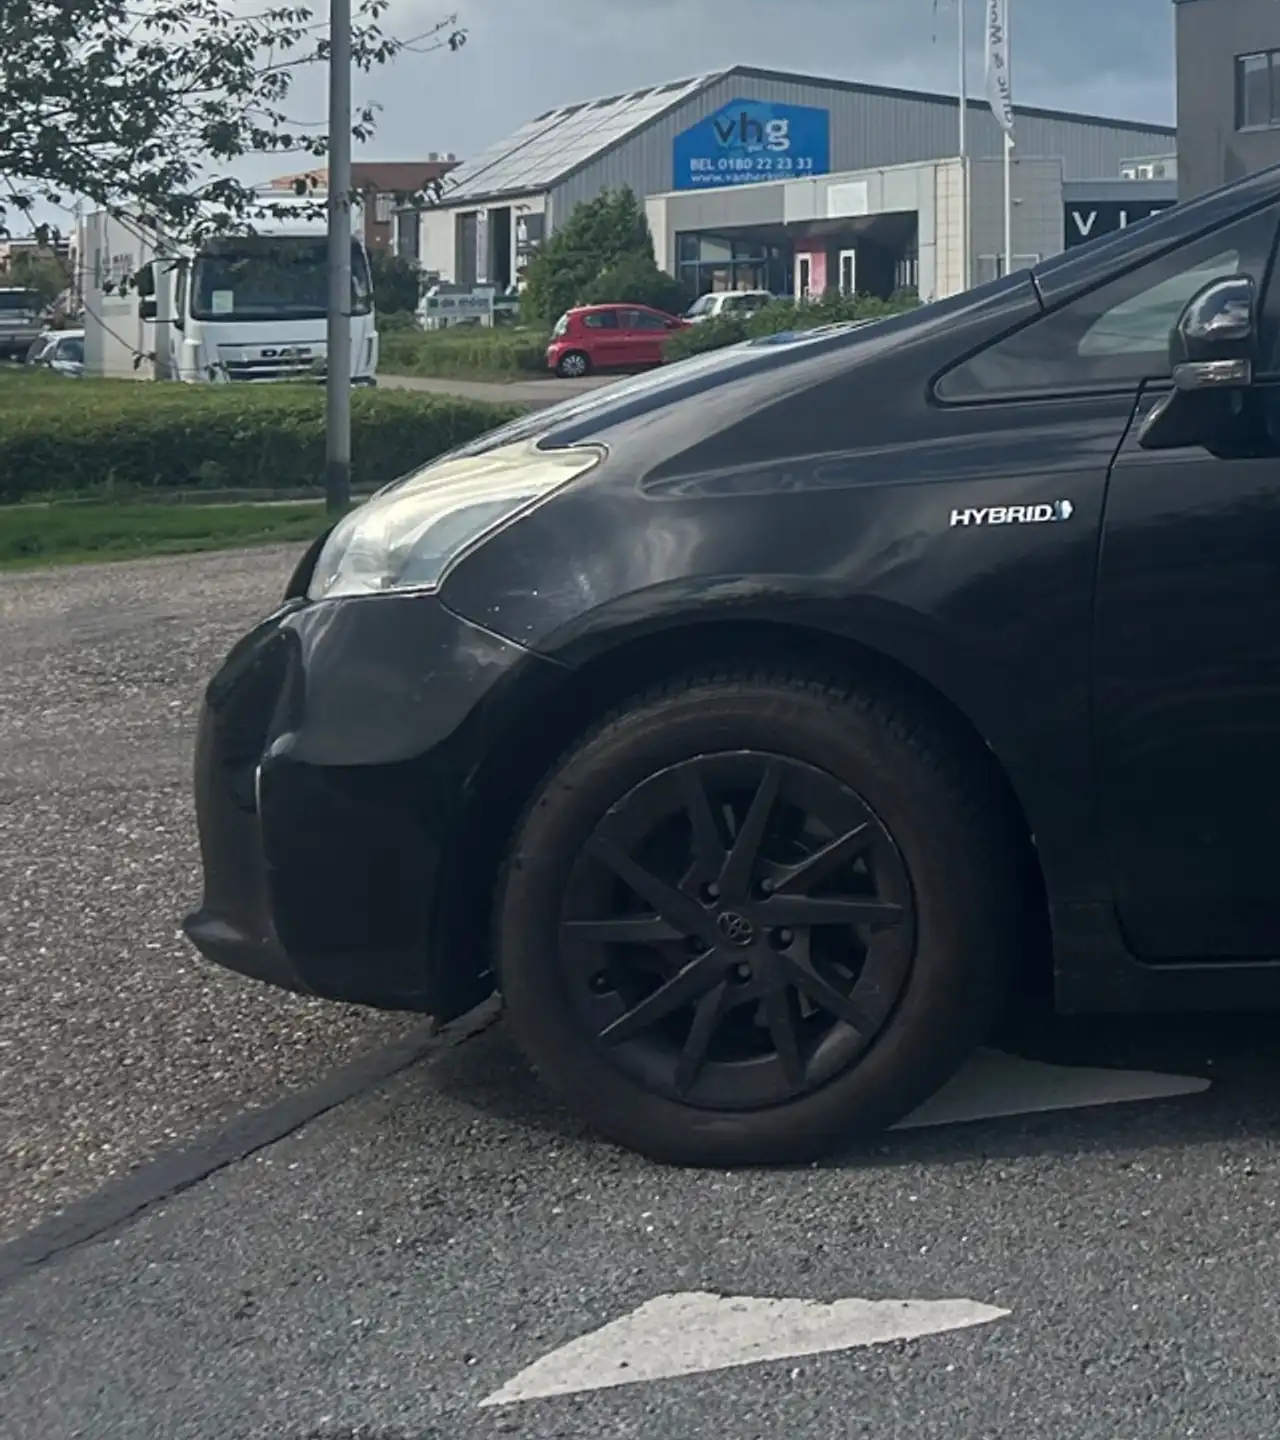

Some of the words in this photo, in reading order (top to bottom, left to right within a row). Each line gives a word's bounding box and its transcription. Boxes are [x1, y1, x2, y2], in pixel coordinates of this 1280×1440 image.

[713, 111, 791, 152] vhg
[690, 158, 714, 171] BEL
[718, 157, 753, 171] 0180
[755, 157, 773, 170] 22
[777, 157, 793, 170] 23
[796, 157, 813, 170] 33
[950, 504, 1053, 527] HYBRID
